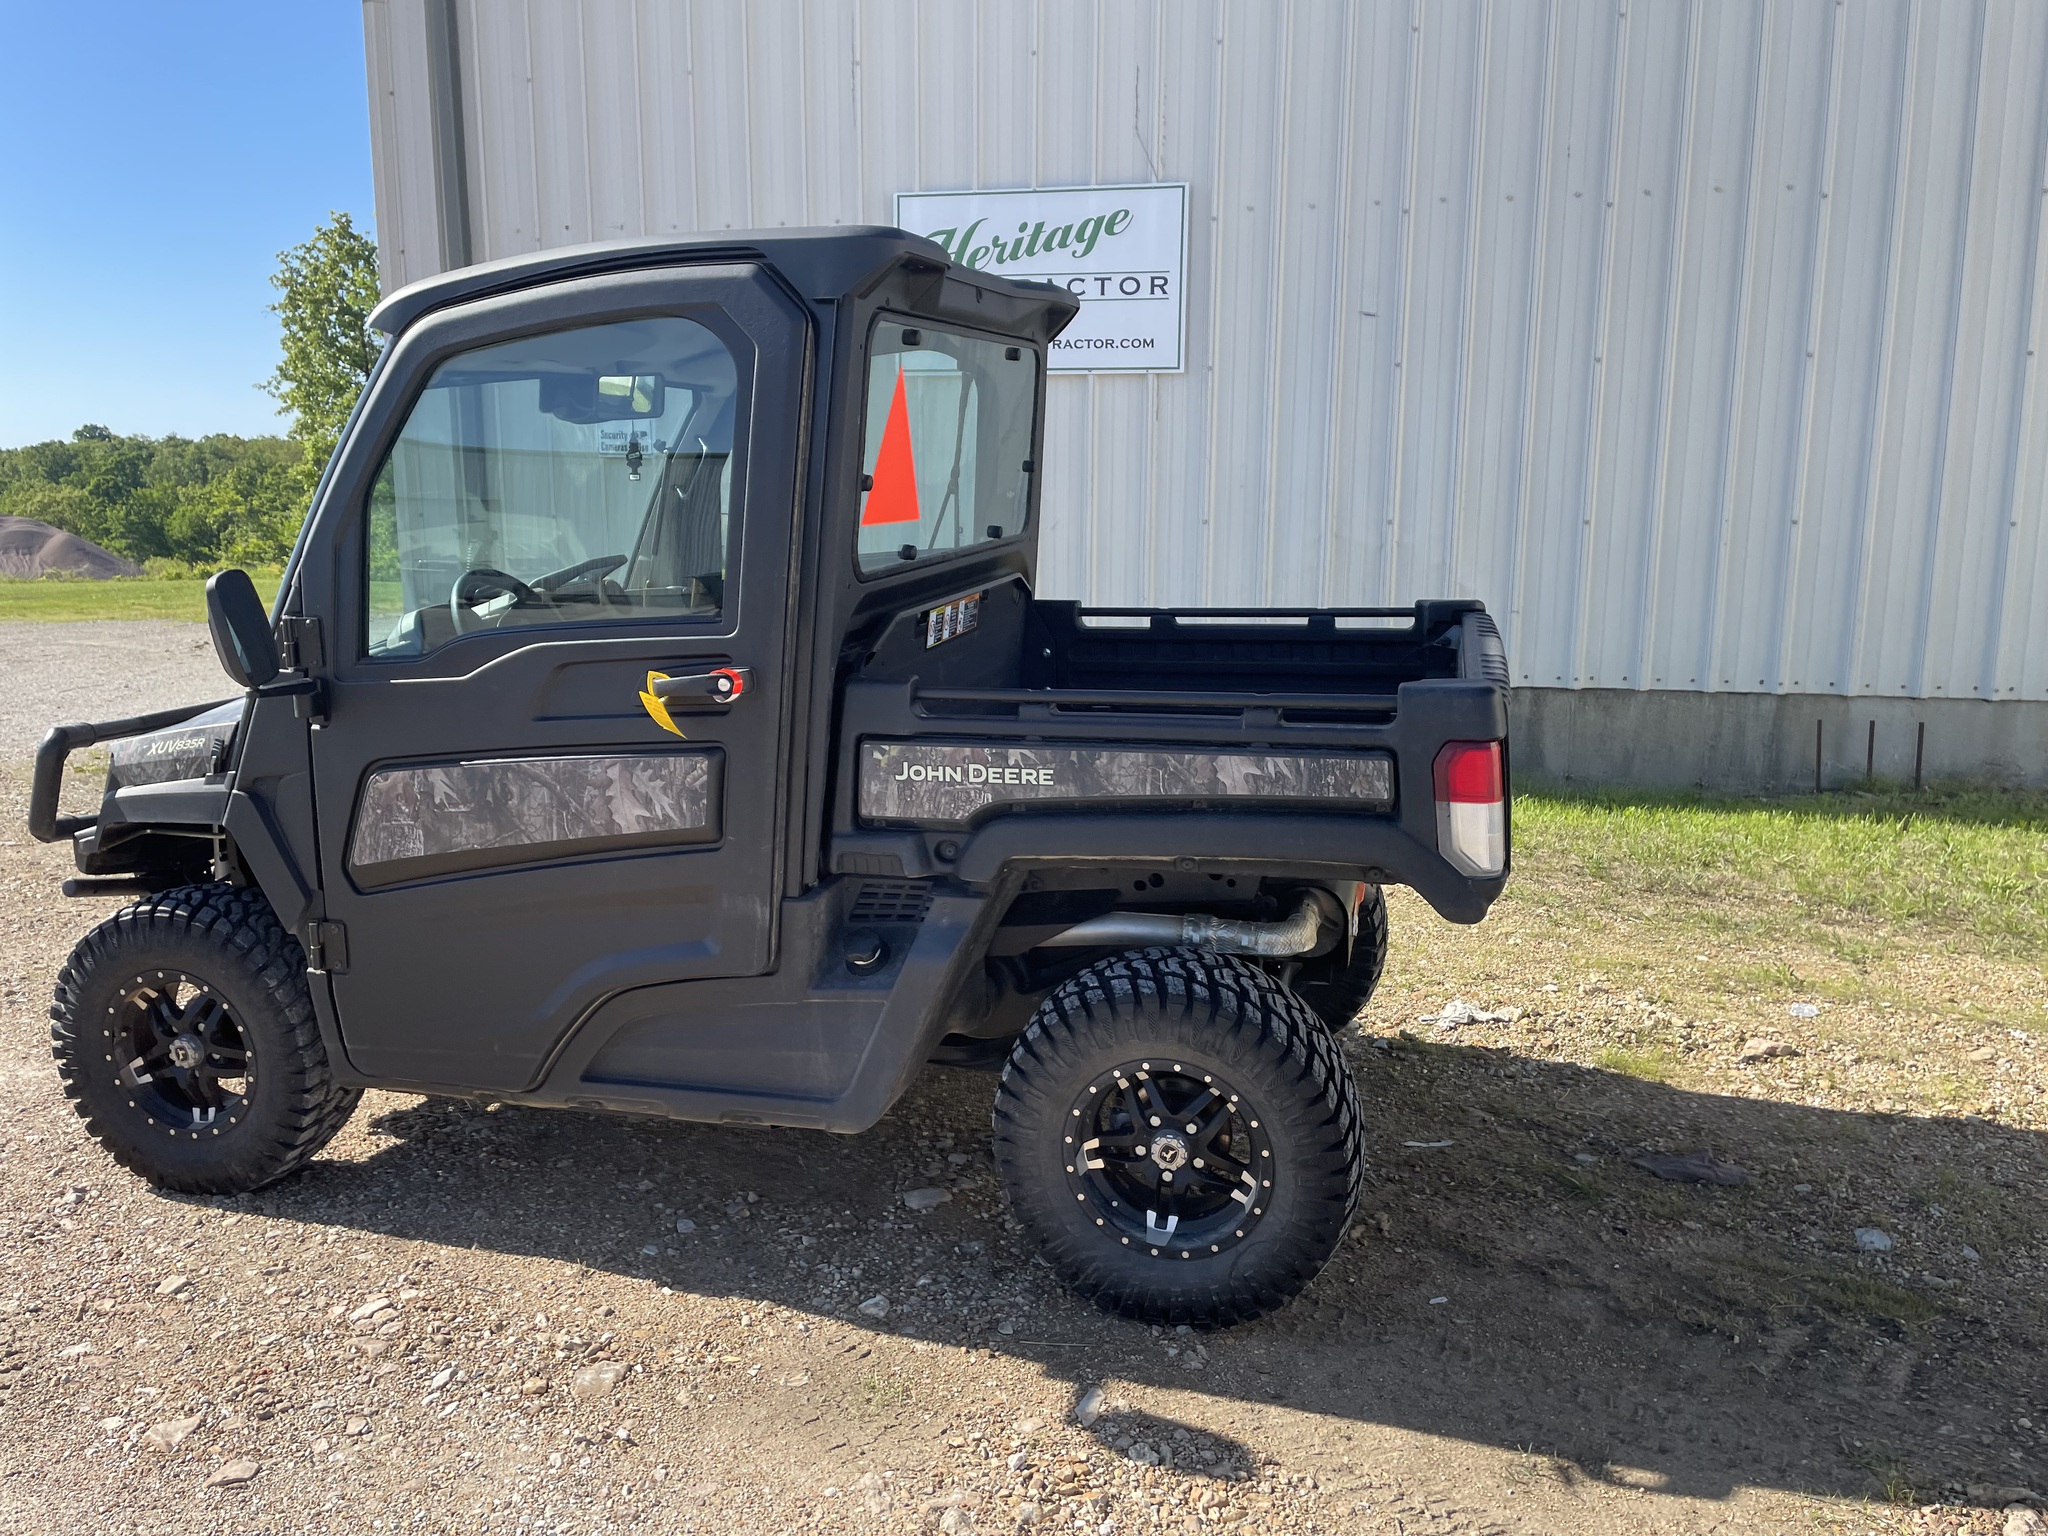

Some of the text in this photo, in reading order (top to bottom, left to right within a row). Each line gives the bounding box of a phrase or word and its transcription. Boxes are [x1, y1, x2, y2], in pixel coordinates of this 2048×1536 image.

[925, 208, 1134, 272] Heritage
[600, 429, 628, 441] Security
[600, 442, 628, 452] Cameras
[146, 737, 206, 756] XUV835R
[895, 761, 1054, 786] JOHN DEERE
